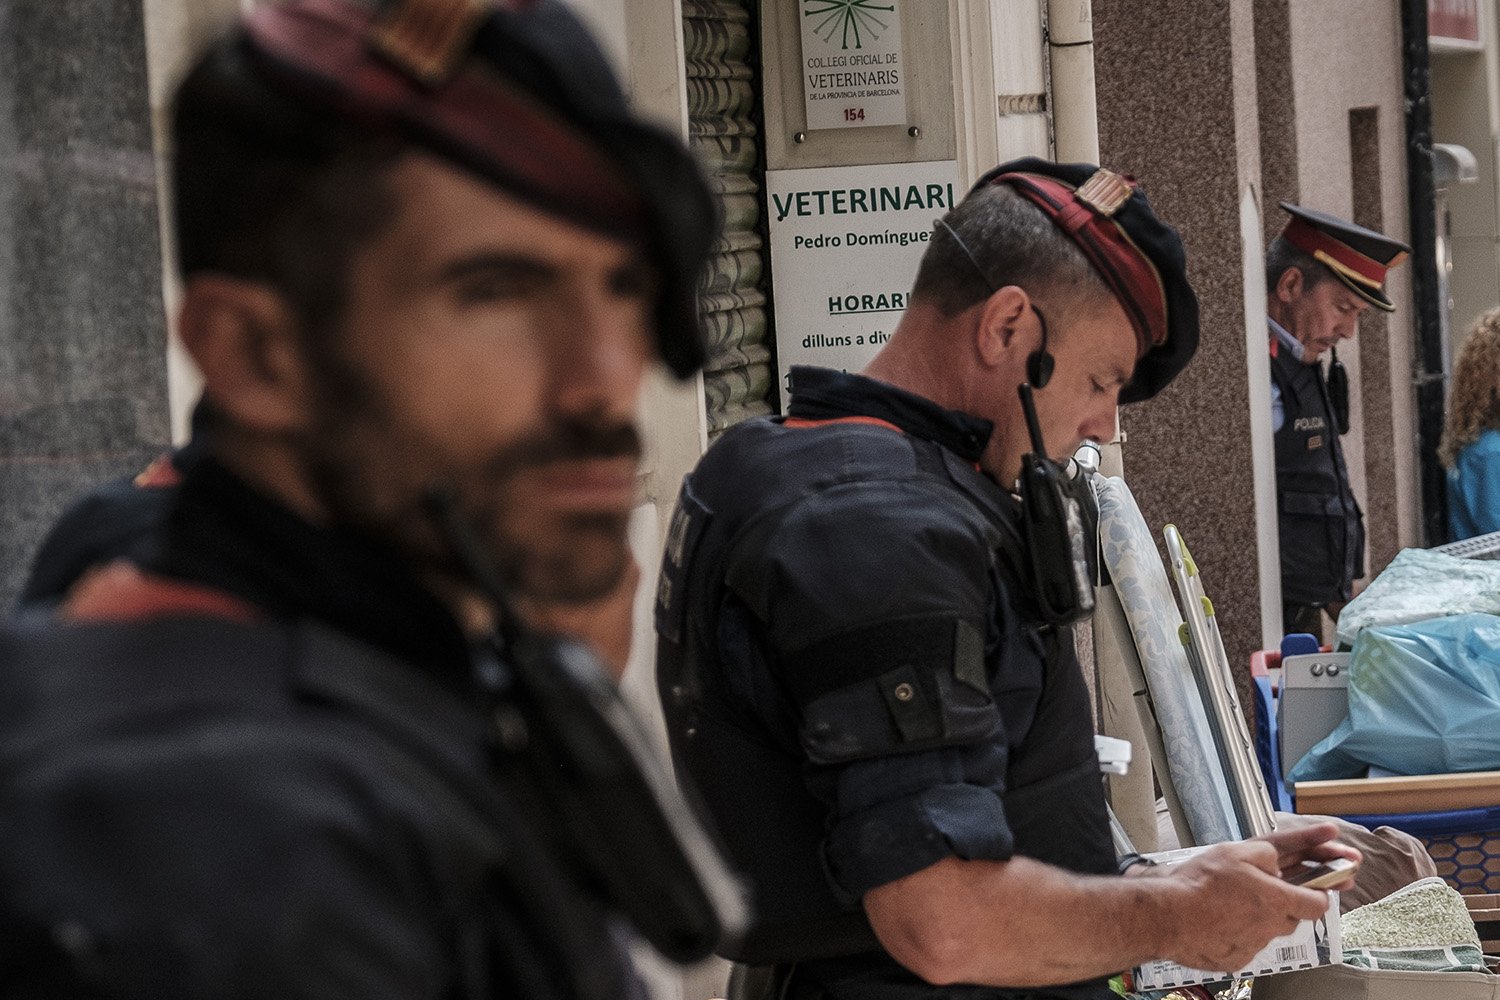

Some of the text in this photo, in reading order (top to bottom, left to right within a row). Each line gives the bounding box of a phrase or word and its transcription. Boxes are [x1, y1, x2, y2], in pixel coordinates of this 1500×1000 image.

[849, 54, 884, 66] OFICIAL
[885, 53, 898, 64] DE
[808, 70, 899, 89] VETERINARIS
[809, 93, 818, 101] DE
[858, 90, 866, 98] DE
[866, 88, 900, 97] BARCELONA
[843, 108, 866, 121] 154
[772, 183, 955, 217] VETERINARI
[794, 234, 841, 249] Pedro
[802, 331, 892, 348] dilluns a div
